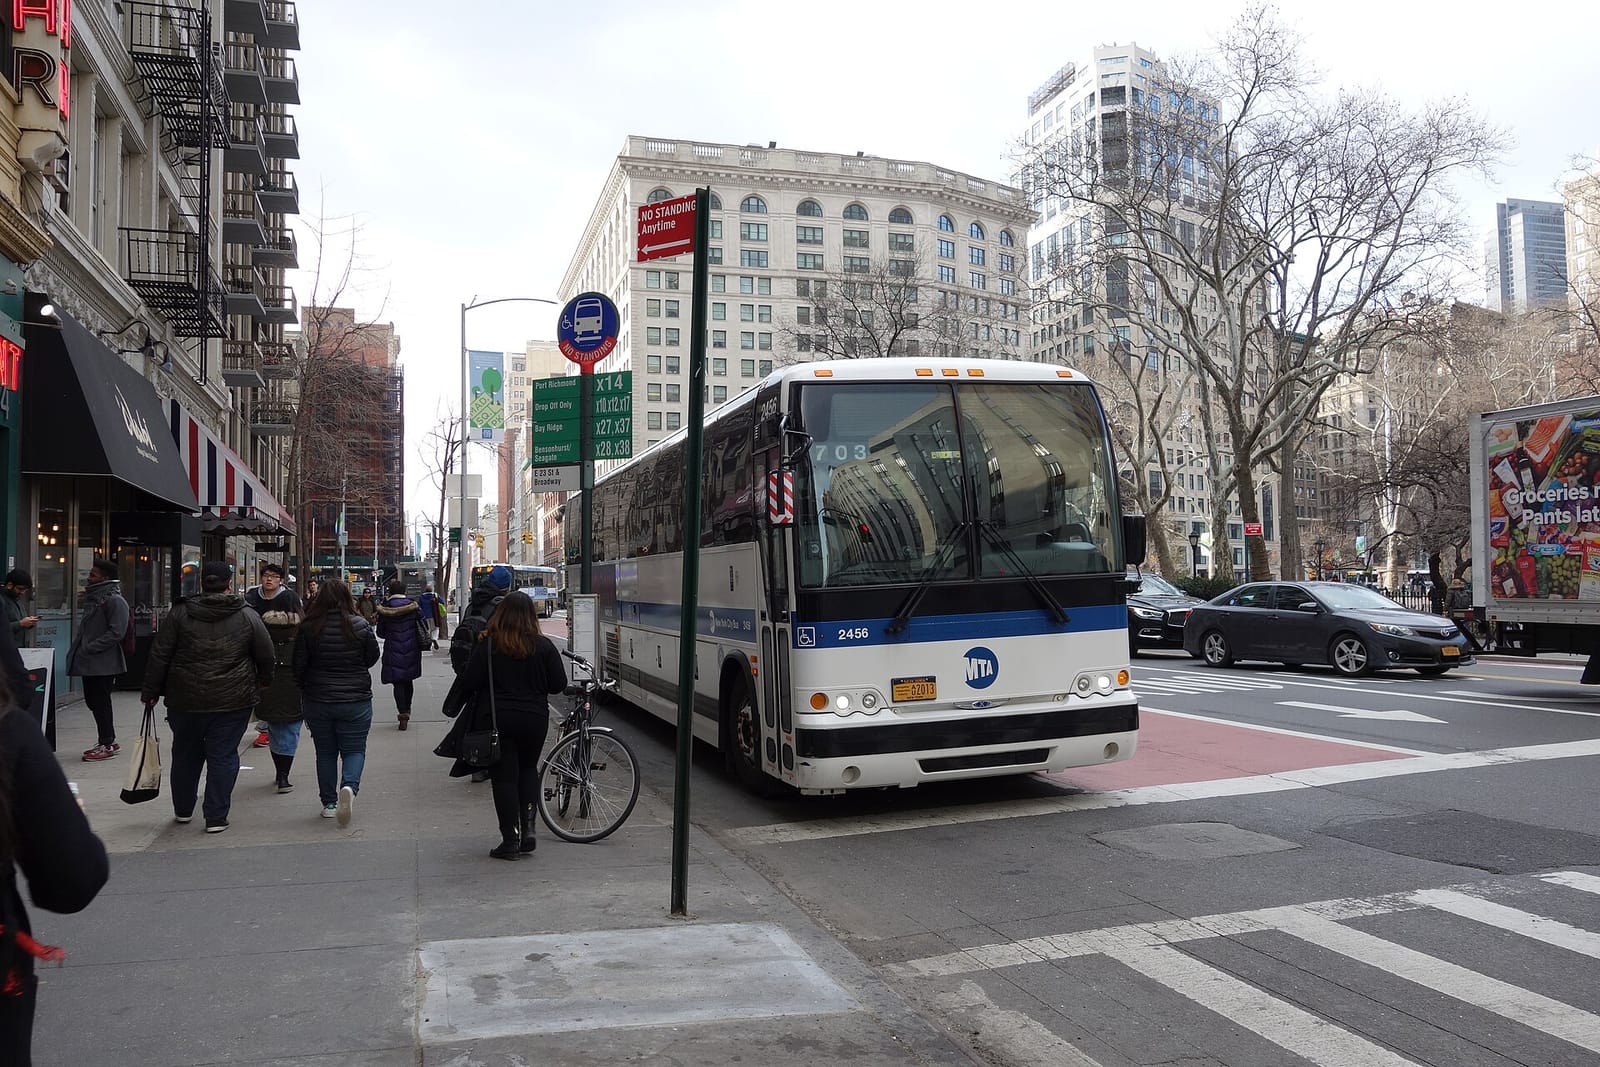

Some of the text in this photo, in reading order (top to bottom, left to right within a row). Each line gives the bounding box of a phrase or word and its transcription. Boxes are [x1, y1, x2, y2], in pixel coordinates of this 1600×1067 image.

[641, 200, 696, 222] NO STANDING
[641, 219, 676, 235] Anytime
[563, 340, 612, 360] NO STANDING
[535, 379, 577, 389] Port Richmond
[596, 374, 624, 392] x14
[535, 400, 572, 411] Drop Off Only
[534, 423, 563, 433] Bay Ridge
[534, 469, 538, 477] E
[534, 478, 561, 486] Broadway
[1506, 482, 1590, 505] Groceries
[1522, 507, 1571, 525] Pants
[838, 627, 869, 640] 2456
[963, 656, 994, 681] MTA
